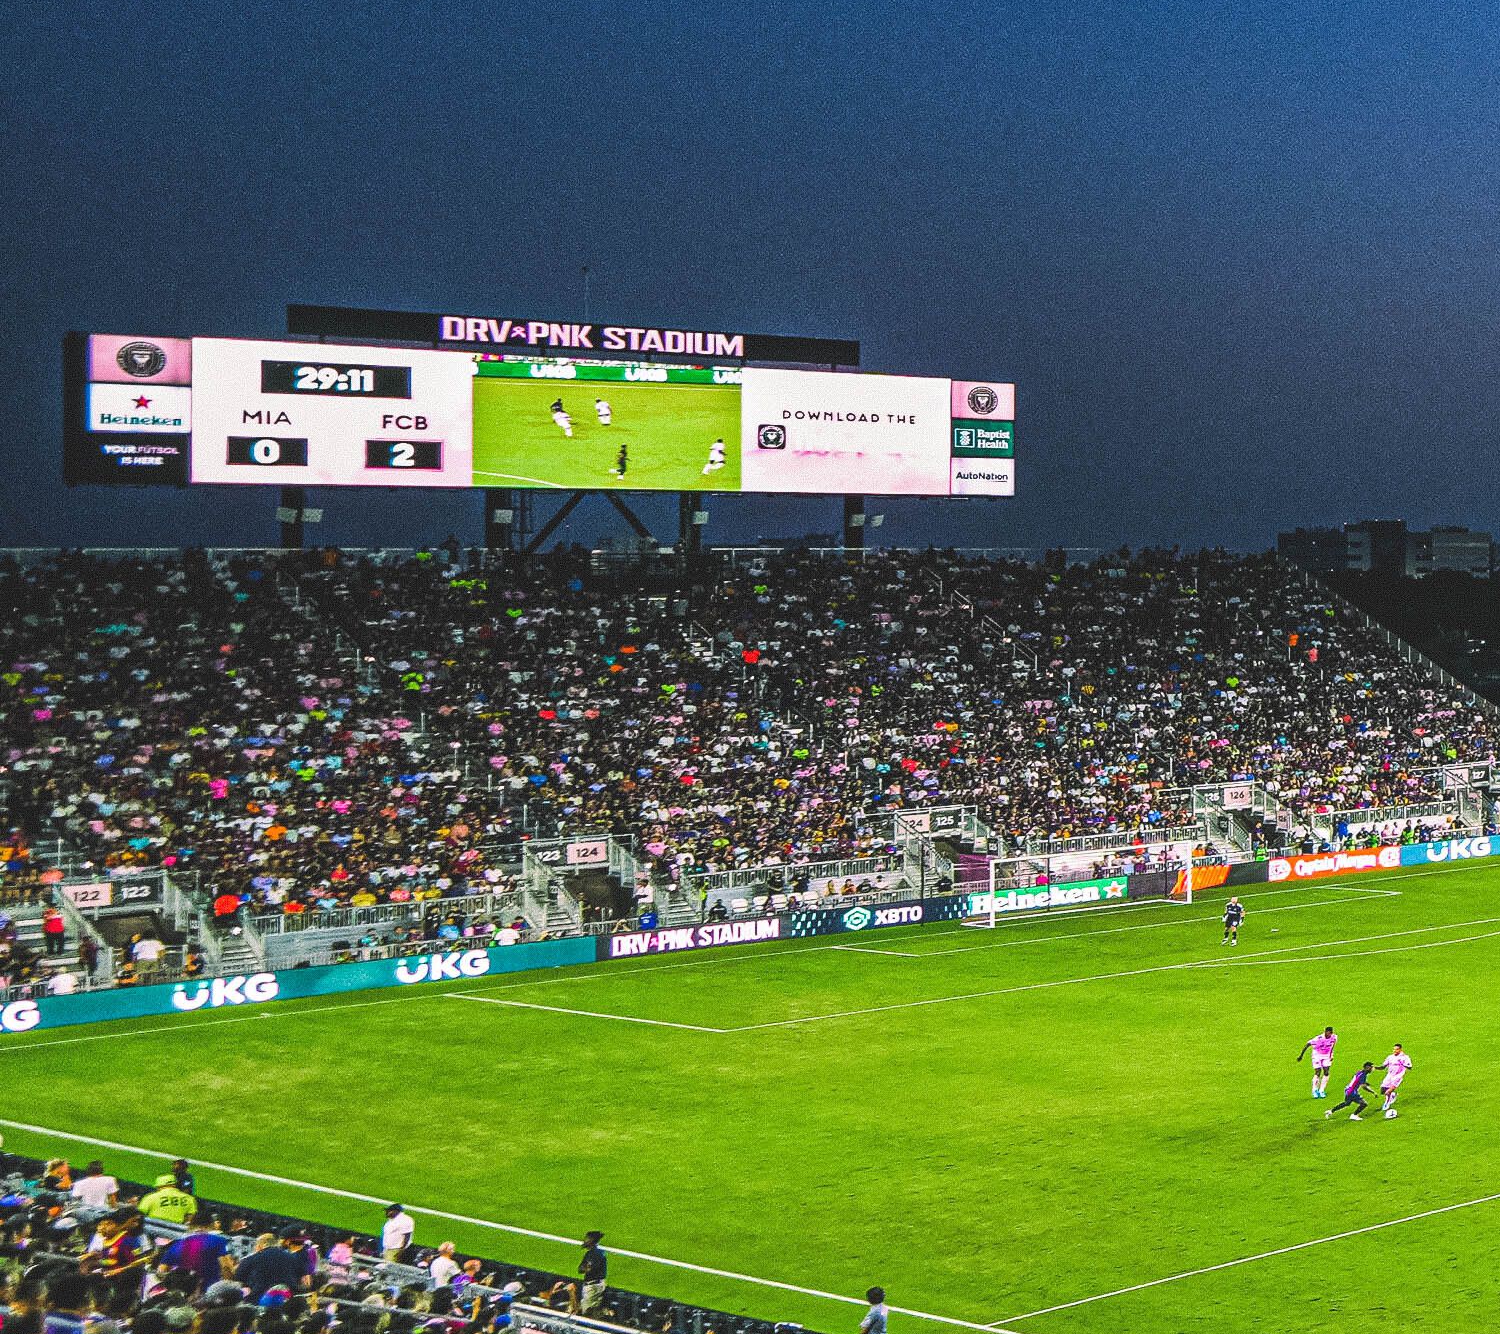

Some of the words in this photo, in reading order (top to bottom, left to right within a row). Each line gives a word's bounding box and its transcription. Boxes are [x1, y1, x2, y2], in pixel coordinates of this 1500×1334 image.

[441, 316, 512, 344] DRV
[529, 320, 595, 348] PNK
[604, 326, 745, 357] STADIUM
[294, 366, 374, 393] 29:11
[101, 413, 183, 428] Heineken
[243, 410, 292, 427] MIA
[383, 415, 428, 431] FCB
[782, 410, 880, 424] DOWNLOAD
[888, 415, 916, 426] THE
[978, 429, 1011, 441] Baptist
[250, 439, 281, 464] 0
[978, 439, 1010, 450] Health
[388, 443, 415, 467] 2
[956, 471, 1009, 482] AutoNation
[1229, 790, 1245, 800] 126
[934, 815, 955, 827] 125
[576, 847, 598, 860] 124
[73, 889, 101, 902] 122
[121, 885, 151, 899] 123
[875, 905, 923, 926] XBTO
[610, 932, 648, 958] DRV
[659, 927, 695, 952] PNK
[699, 918, 780, 948] STADIUM
